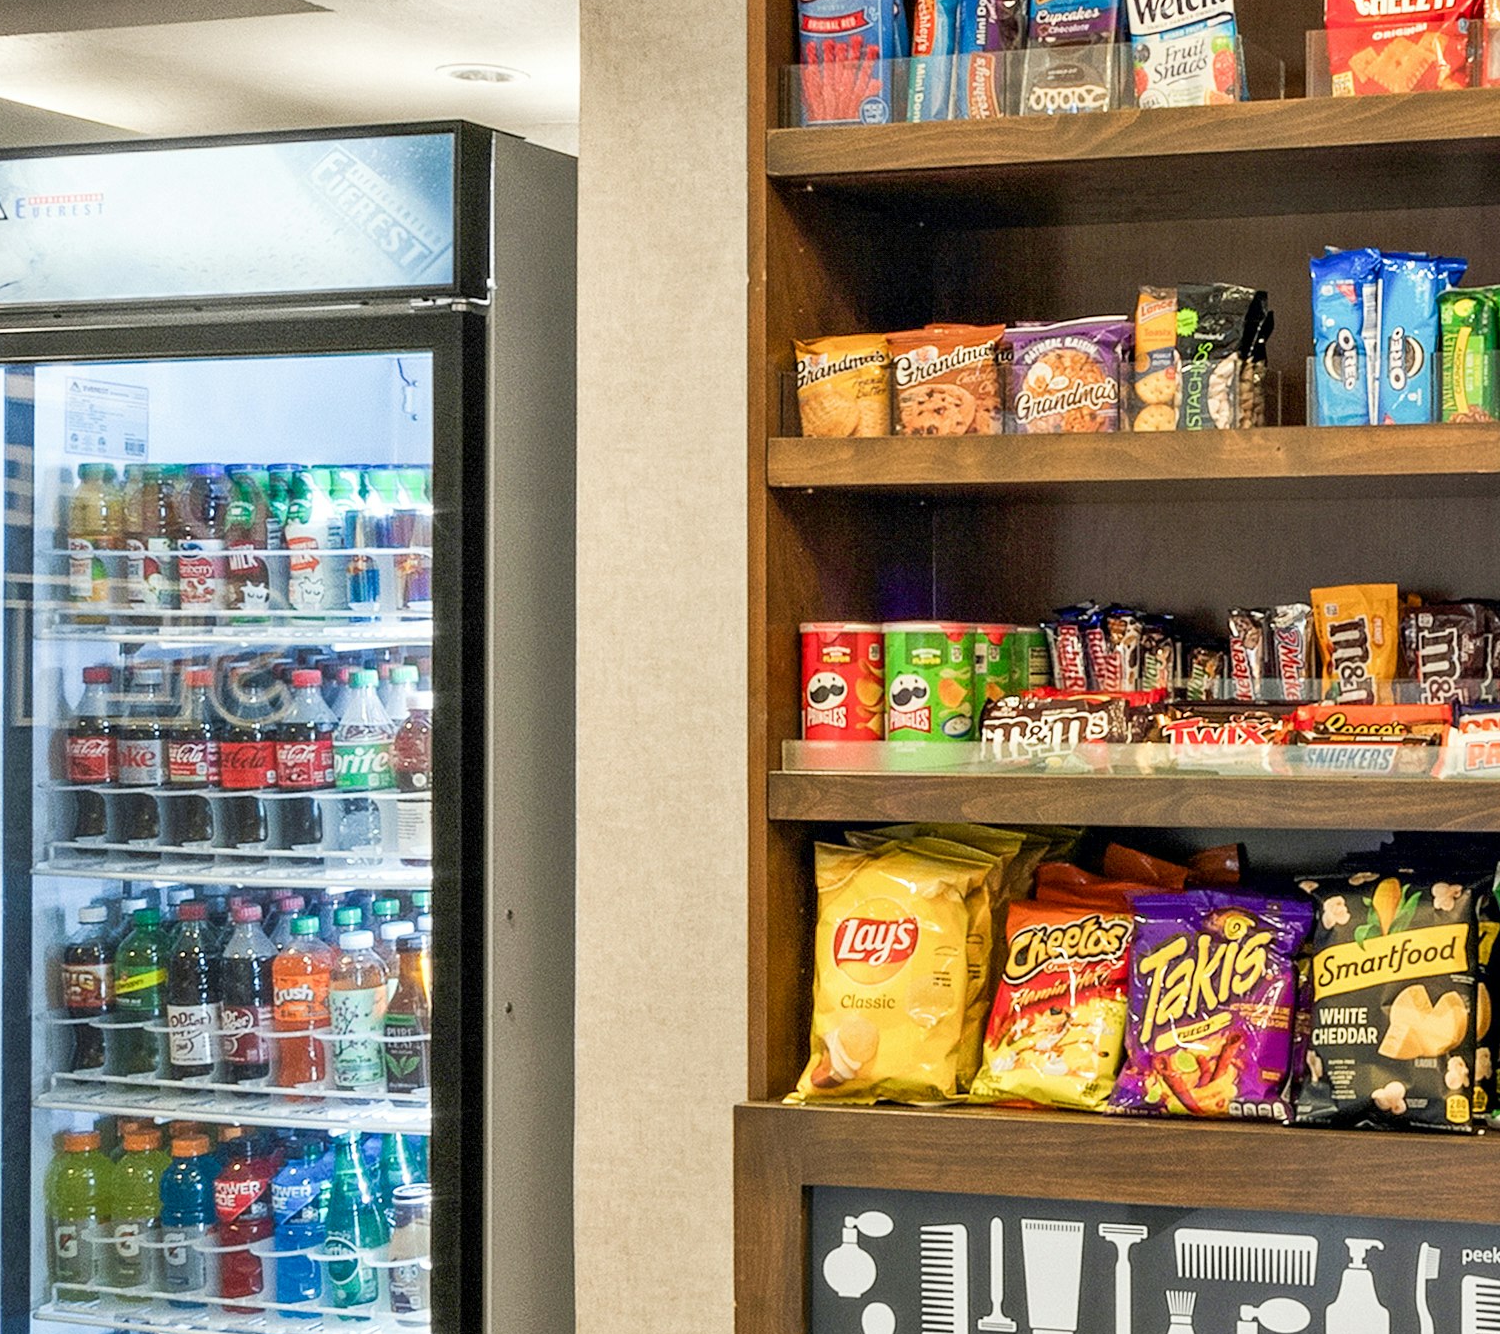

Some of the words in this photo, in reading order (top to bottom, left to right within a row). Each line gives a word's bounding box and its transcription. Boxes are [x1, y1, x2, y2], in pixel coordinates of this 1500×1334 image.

[1036, 7, 1100, 24] Cupcakes
[1164, 38, 1205, 62] Fruit
[1153, 54, 1208, 83] Snacks
[1337, 327, 1358, 391] OREO
[1388, 326, 1406, 391] OREO
[1015, 377, 1119, 423] Grandma's
[807, 707, 847, 728] PRINGLES
[889, 707, 930, 731] PRINGLES
[1164, 717, 1268, 756] TWIX
[1304, 746, 1395, 772] SNICKERS
[837, 916, 916, 966] Lay's
[1003, 916, 1131, 982] Cheetos
[1318, 935, 1457, 988] Smartfood
[1139, 930, 1273, 1043] Takis
[840, 993, 897, 1010] Classic
[1319, 1008, 1368, 1025] WHITE
[1312, 1026, 1377, 1046] CHEDDAR
